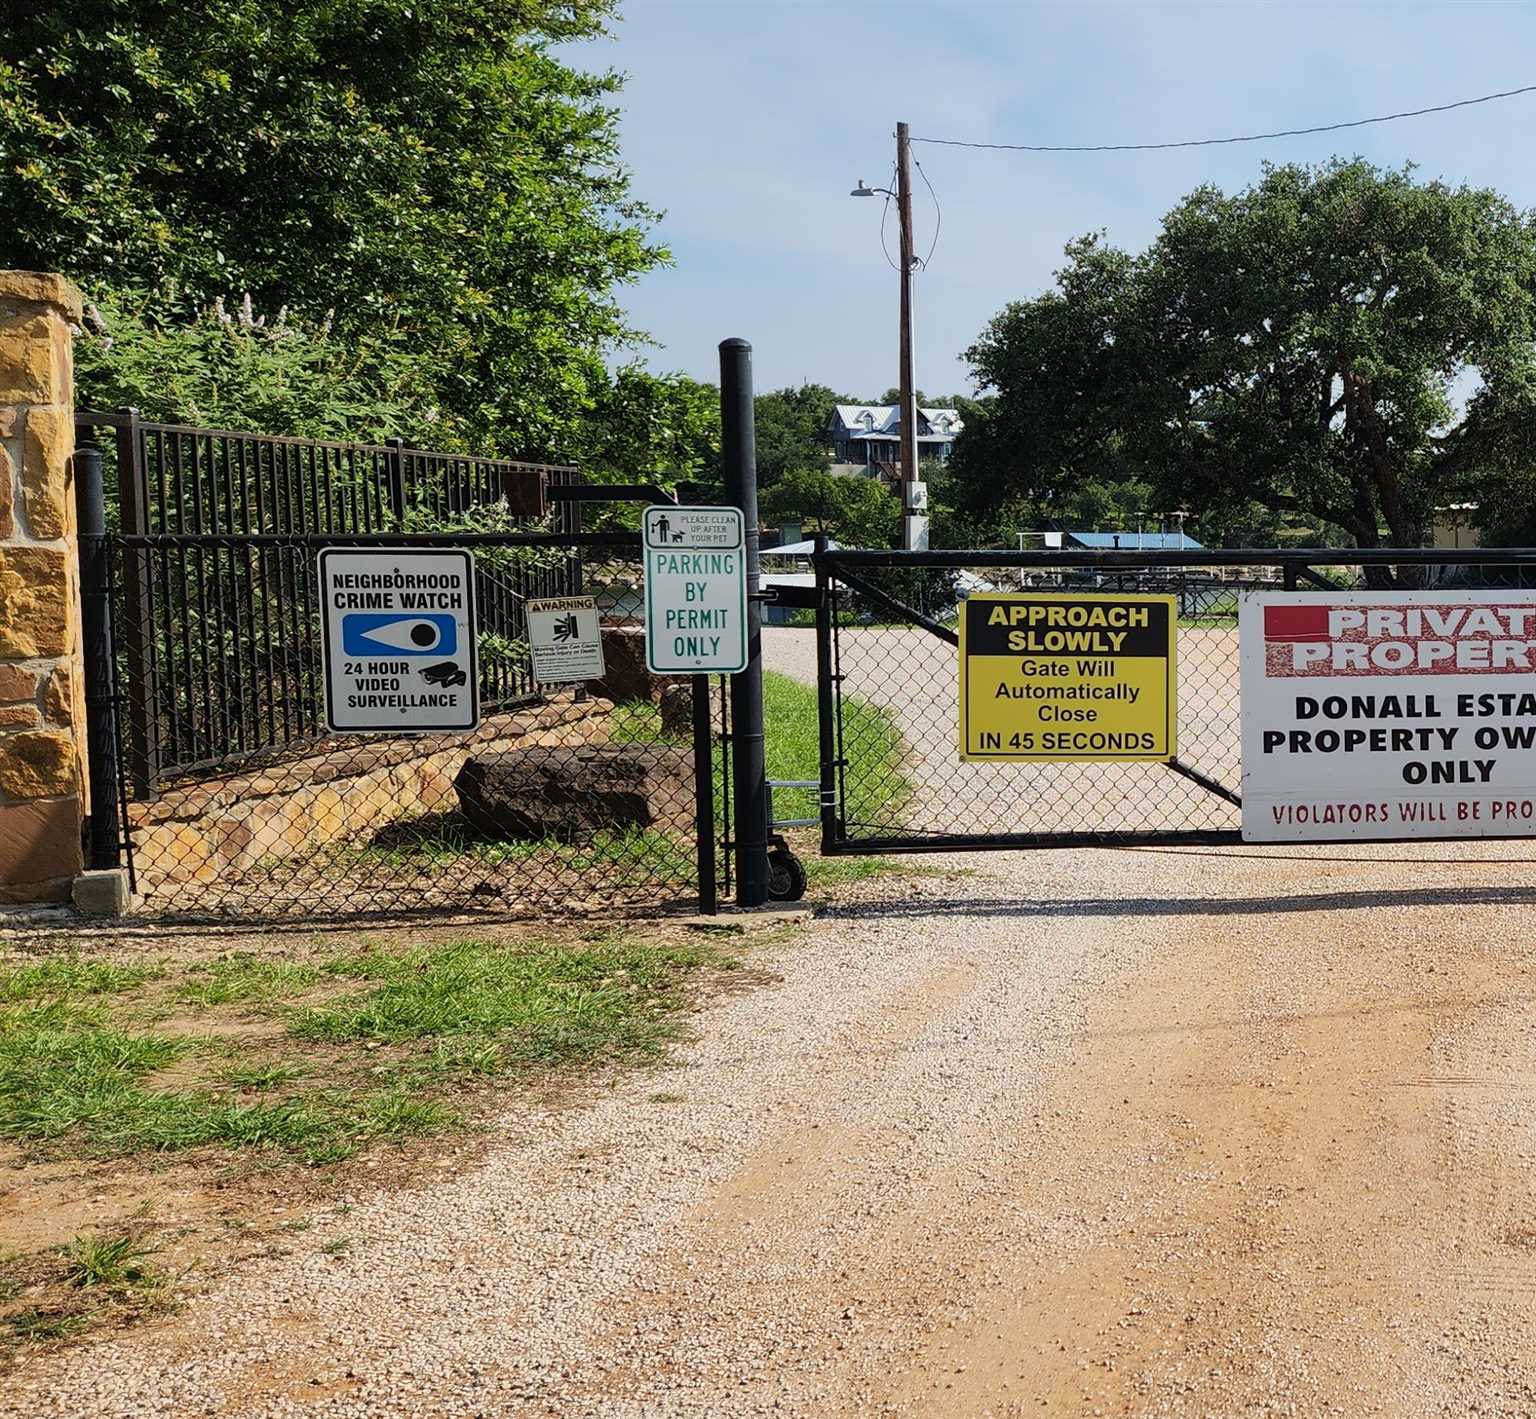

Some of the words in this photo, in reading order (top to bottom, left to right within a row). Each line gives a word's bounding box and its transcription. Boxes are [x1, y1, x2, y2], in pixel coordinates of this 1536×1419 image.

[657, 554, 734, 575] PARKING
[333, 574, 460, 588] NEIGHBORHOOD
[335, 593, 393, 609] CRIME
[400, 593, 461, 608] WATCH
[686, 583, 707, 601] BY
[540, 599, 592, 610] WARNING
[666, 610, 728, 629] PERMIT
[988, 606, 1148, 627] APPROACH
[675, 637, 720, 656] ONLY
[1008, 631, 1128, 651] SLOWLY
[344, 663, 363, 674] 24
[369, 663, 409, 674] HOUR
[1022, 660, 1069, 676] Gate
[1077, 660, 1114, 677] Will
[355, 679, 399, 691] VIDEO
[996, 683, 1139, 703] Automatically
[348, 695, 456, 707] SURVEILLANCE
[1296, 695, 1441, 720] DONALL
[1038, 705, 1097, 721] Close
[980, 733, 1001, 749] IN
[1009, 733, 1034, 749] 45
[1042, 733, 1154, 750] SECONDS
[1264, 728, 1459, 753] PROPERTY
[1402, 760, 1496, 784] ONLY
[1272, 803, 1388, 824] VIOLATORS
[1399, 802, 1446, 822] WILL
[1457, 800, 1481, 820] BE
